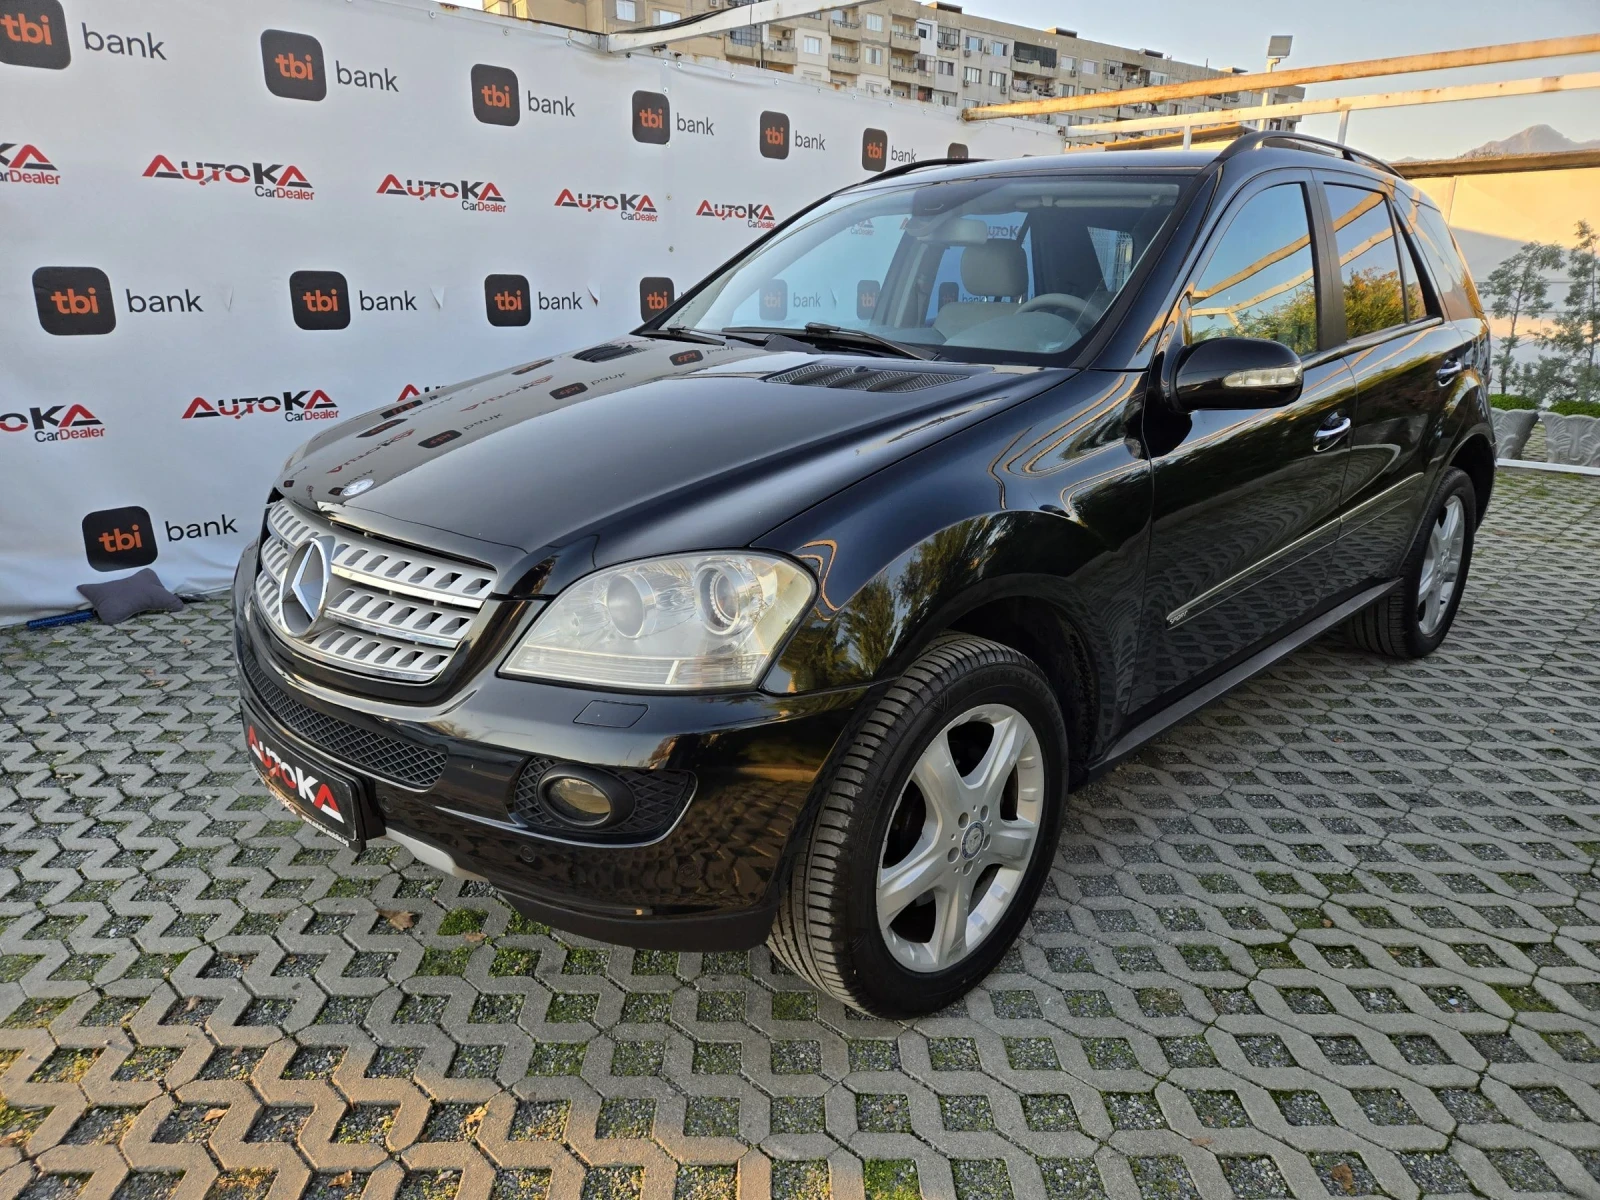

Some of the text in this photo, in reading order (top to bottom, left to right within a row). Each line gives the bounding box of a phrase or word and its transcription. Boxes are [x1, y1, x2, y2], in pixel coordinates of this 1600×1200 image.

[0, 13, 167, 60] tbi bank
[275, 53, 399, 92] tbi bank
[481, 85, 575, 117] tbi bank
[639, 109, 715, 136] tbi bank
[766, 127, 826, 150] tbi bank
[867, 142, 917, 163] tbi bank
[254, 185, 314, 200] CarDealer
[461, 200, 506, 212] CarDealer
[620, 211, 658, 222] CarDealer
[51, 288, 203, 314] tbi bank
[303, 290, 417, 311] tbi bank
[494, 291, 582, 310] tbi bank
[647, 291, 668, 310] tbi
[793, 292, 821, 308] bank
[285, 409, 339, 422] CarDealer
[34, 427, 105, 443] CarDealer
[99, 514, 238, 552] tbi bank
